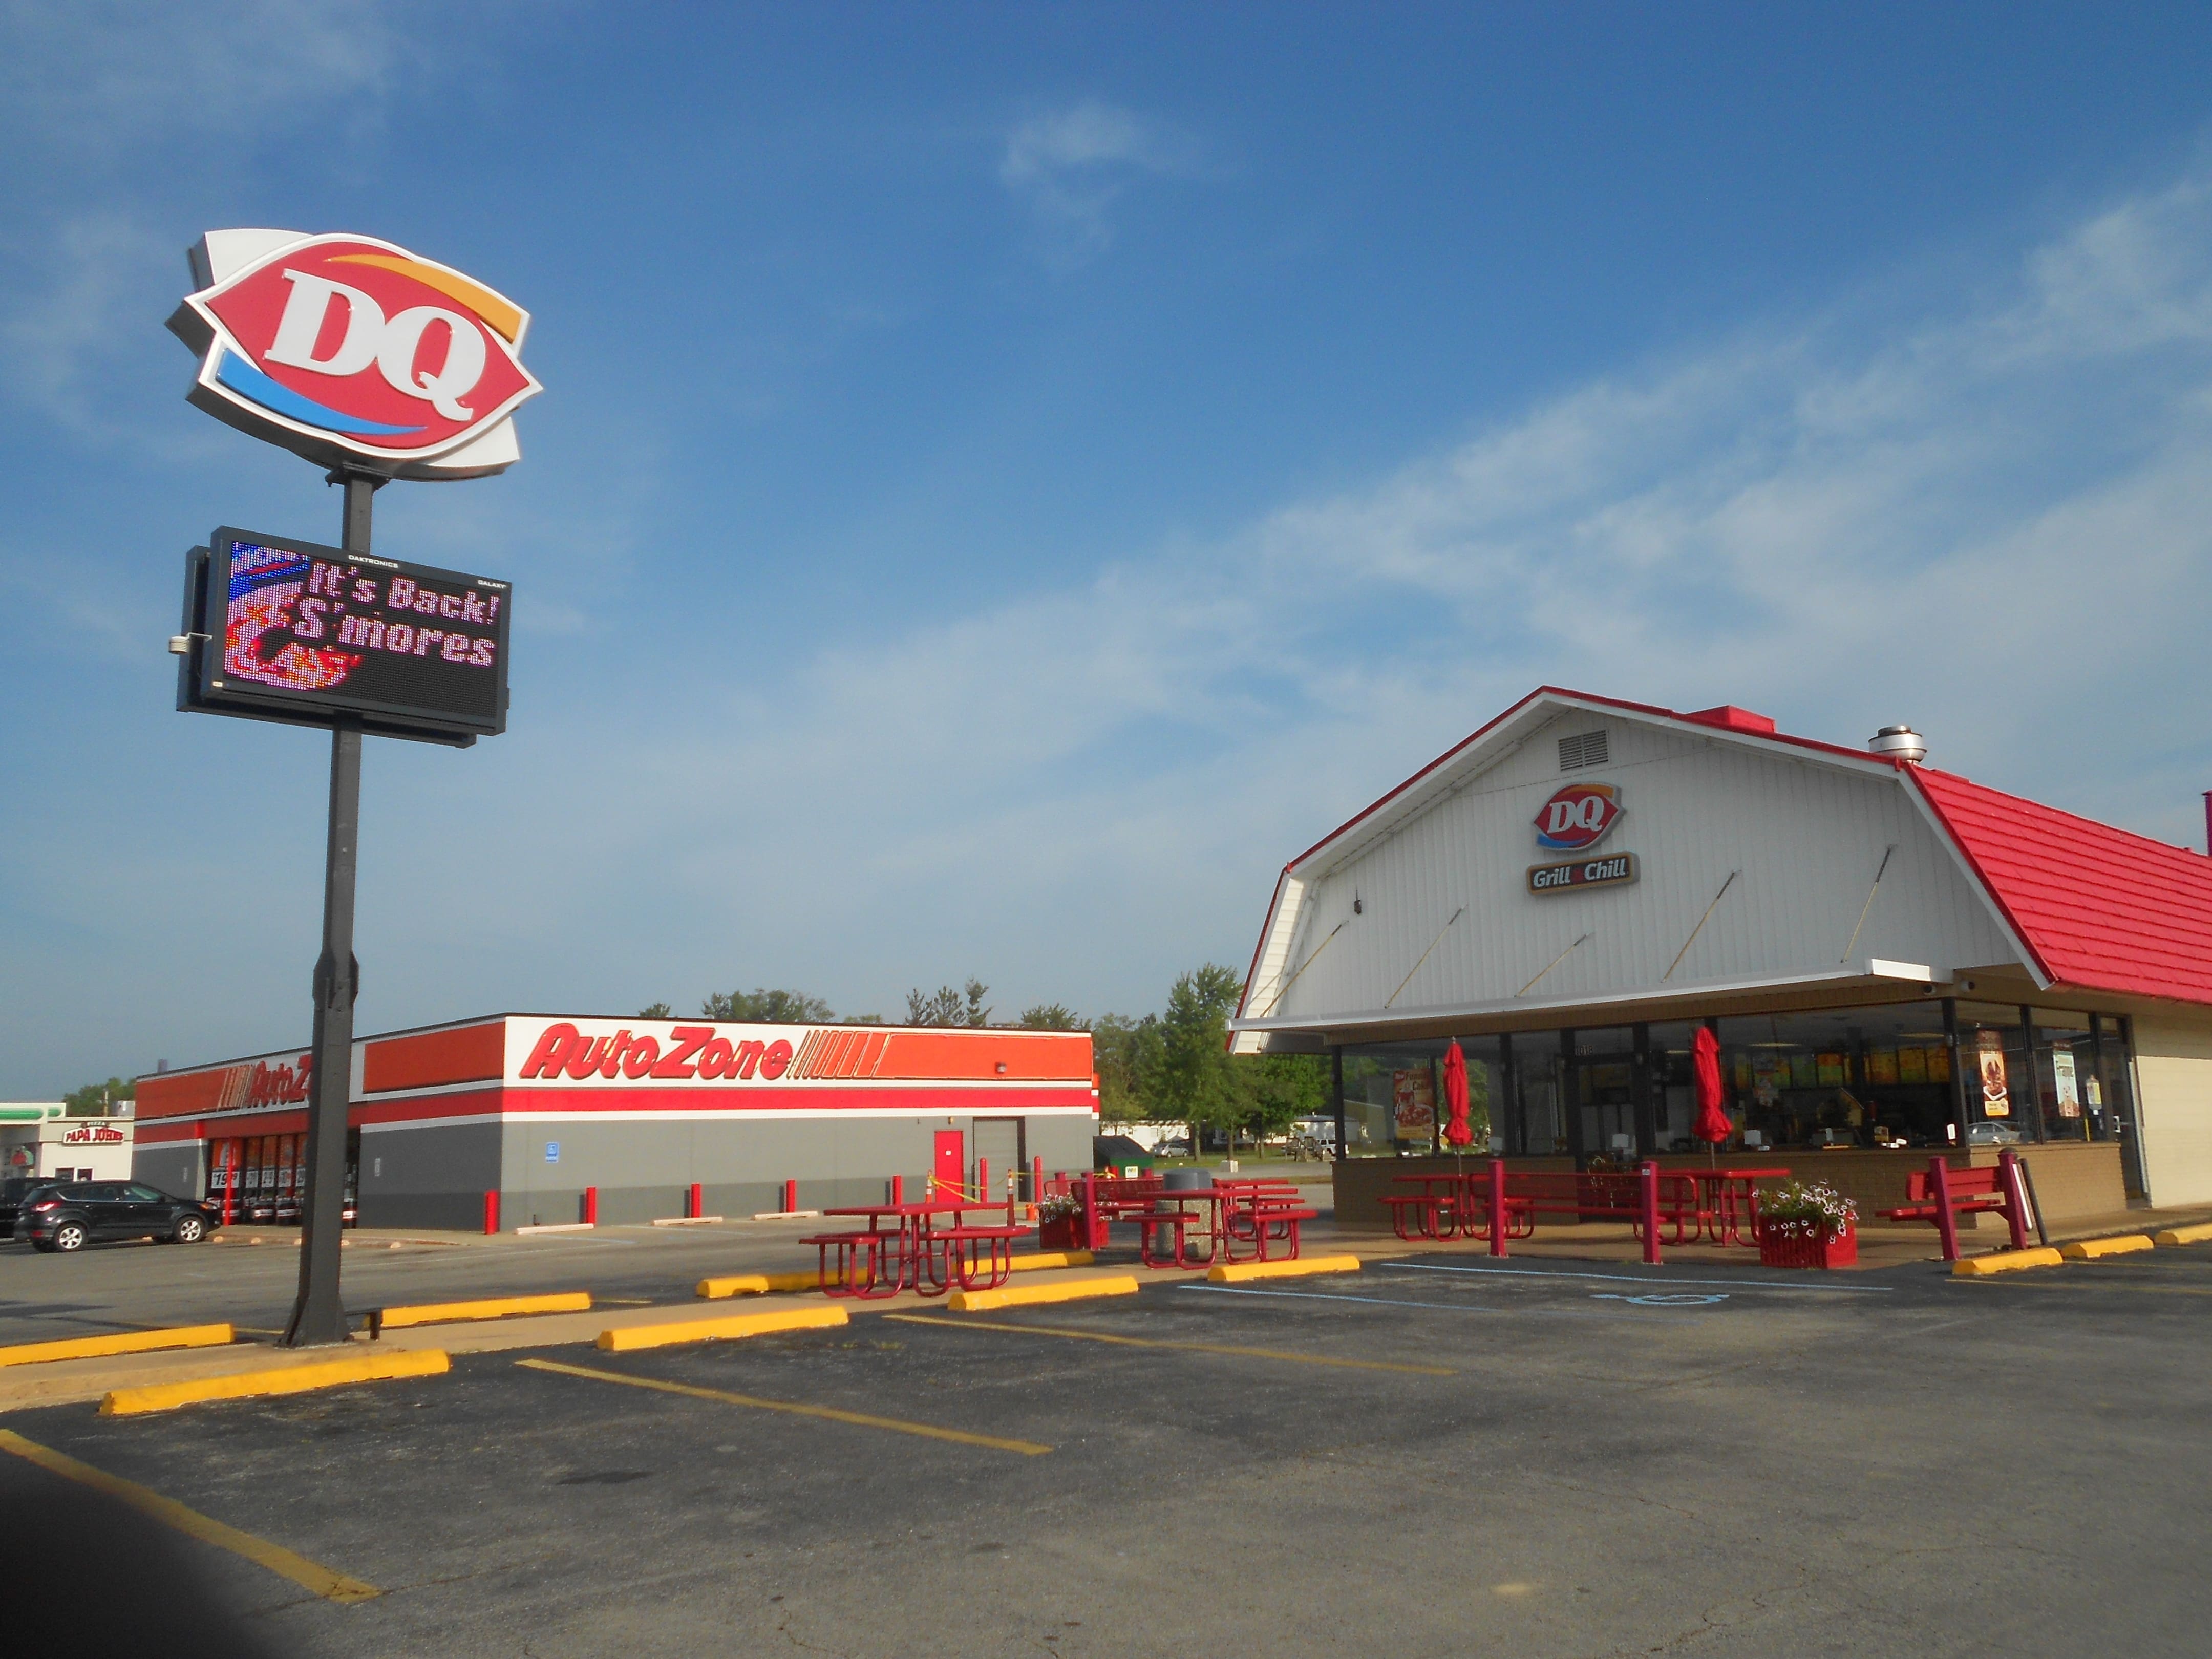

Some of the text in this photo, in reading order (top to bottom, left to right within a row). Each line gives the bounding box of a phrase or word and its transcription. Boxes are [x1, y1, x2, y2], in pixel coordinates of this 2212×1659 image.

[263, 268, 486, 421] DQ
[348, 555, 398, 568] DAKTRONICS
[477, 579, 505, 589] GALAXY
[308, 562, 500, 625] It's Back!
[293, 598, 497, 667] S'mores
[1547, 796, 1604, 834] DQ
[1534, 858, 1626, 887] Grill Chill
[519, 1023, 793, 1080] AutoZone
[246, 1053, 313, 1108] AutoZ
[66, 1129, 90, 1142] PAPA
